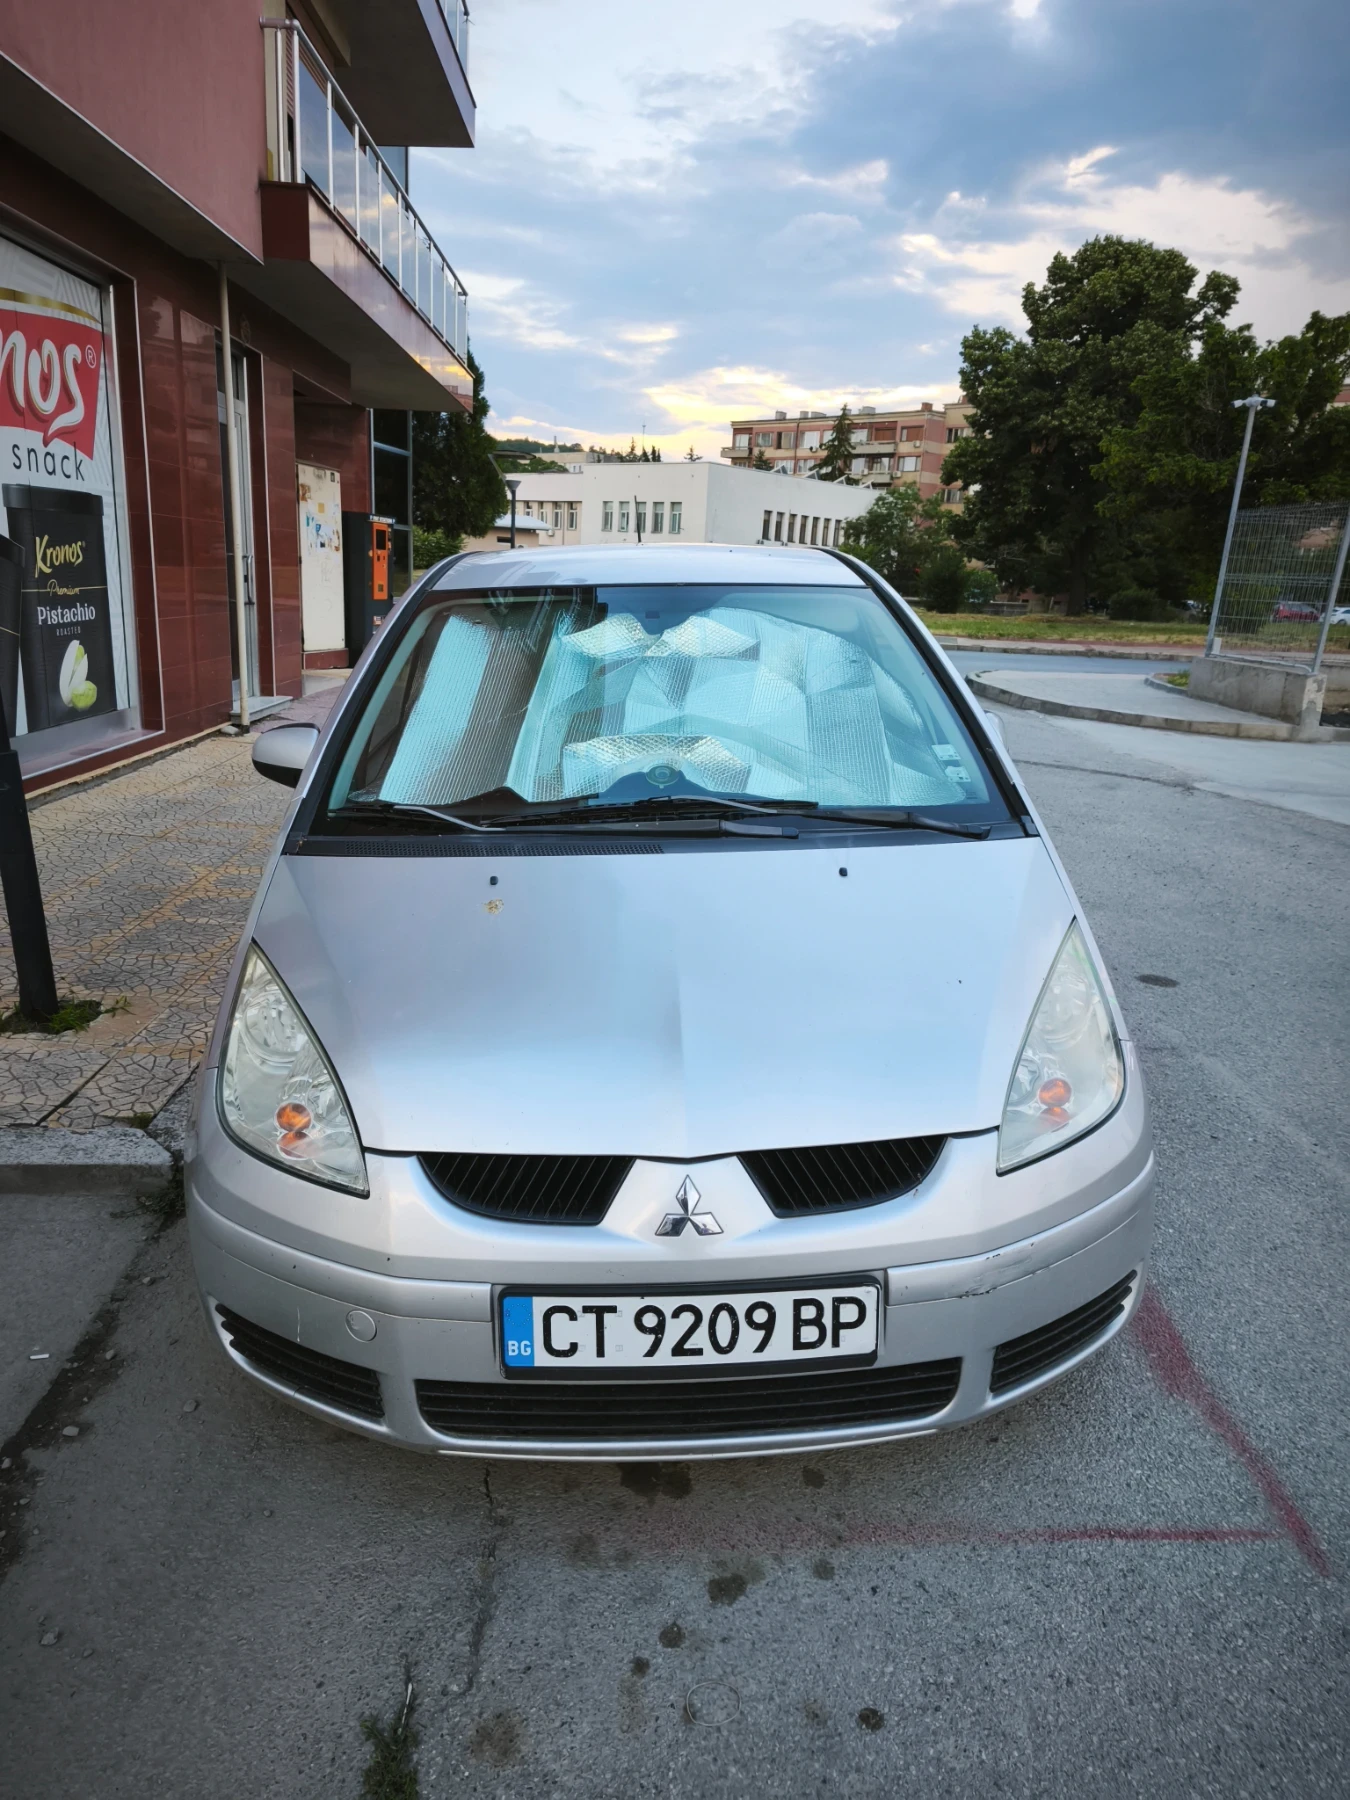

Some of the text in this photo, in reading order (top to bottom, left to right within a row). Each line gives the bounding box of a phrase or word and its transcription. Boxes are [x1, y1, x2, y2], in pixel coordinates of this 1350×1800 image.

[12, 441, 85, 482] snack
[35, 534, 83, 578] Kronos
[47, 579, 80, 597] Premium
[37, 602, 96, 625] Pistachio
[56, 626, 81, 636] ROASTED
[542, 1296, 867, 1359] CT 9209 BP
[508, 1340, 532, 1356] BG
